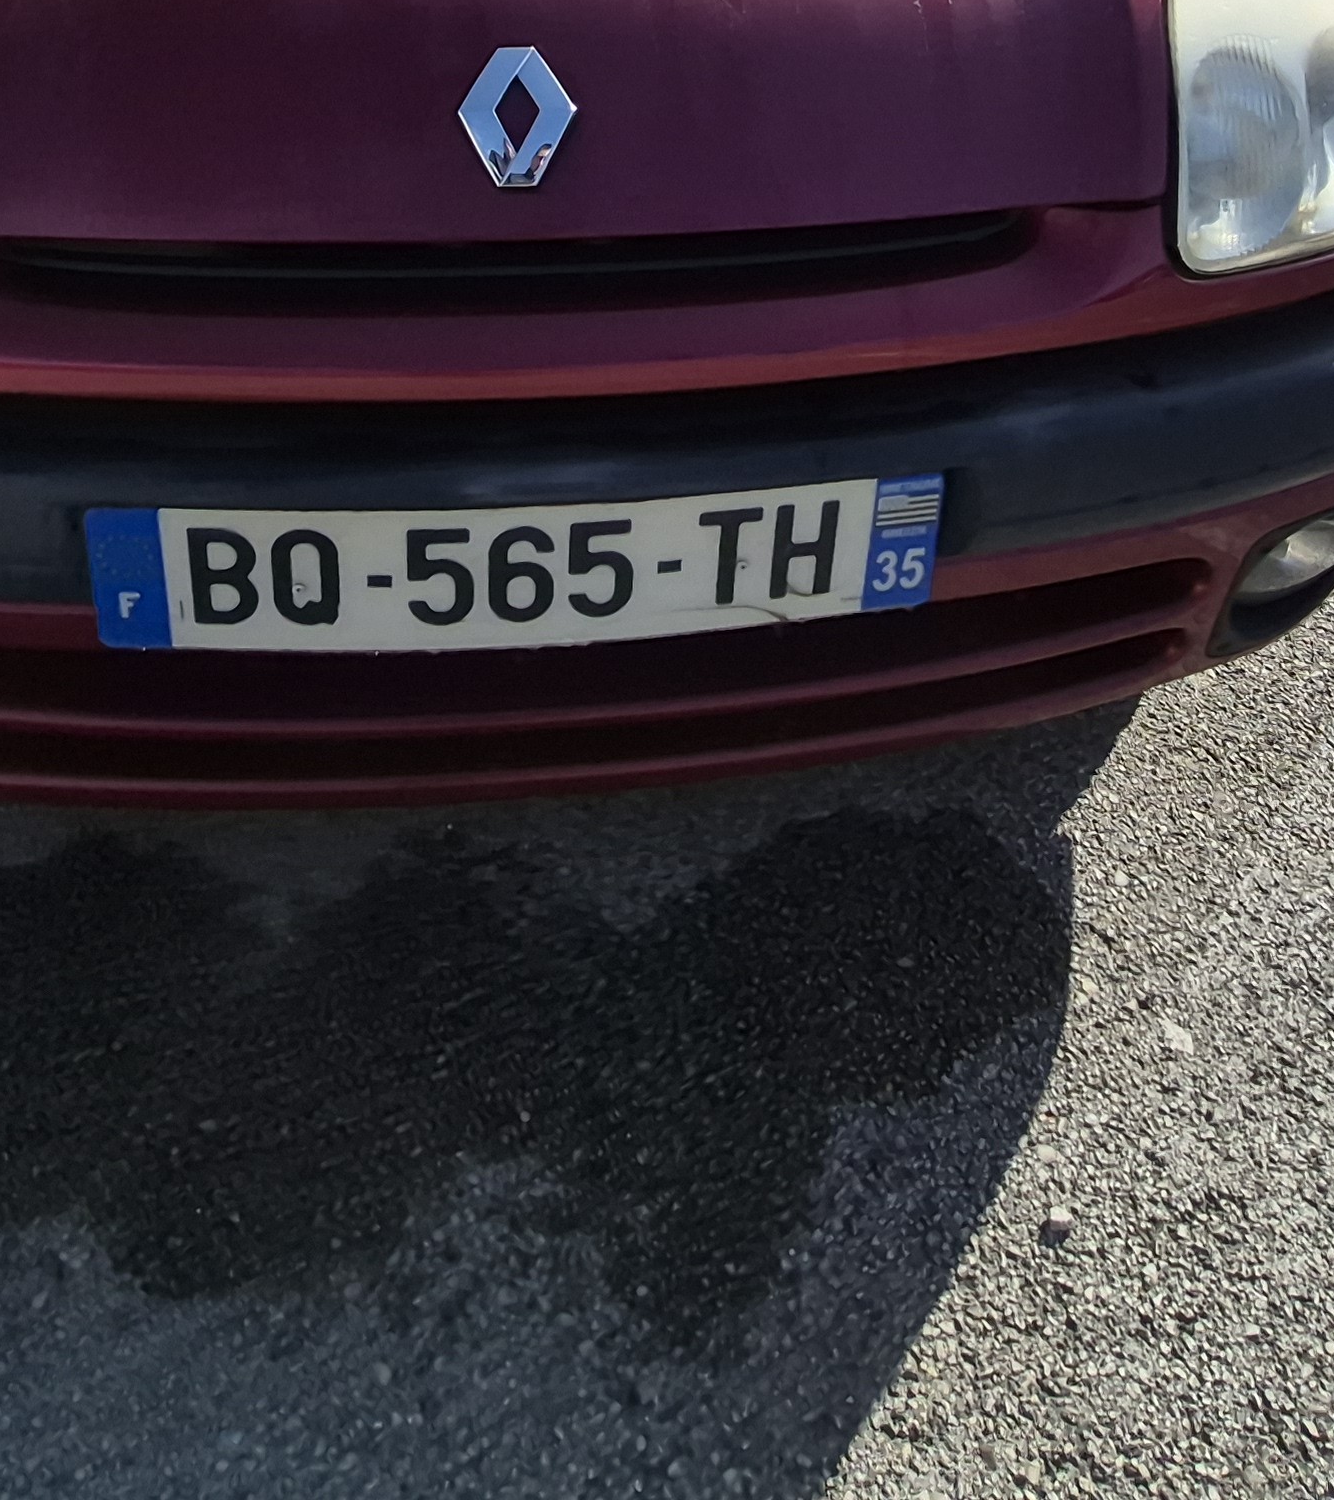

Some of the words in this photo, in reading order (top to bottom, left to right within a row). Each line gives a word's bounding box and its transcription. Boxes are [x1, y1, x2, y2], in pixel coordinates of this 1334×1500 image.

[186, 500, 840, 625] BQ-565-TH
[872, 547, 926, 592] 35
[118, 591, 141, 618] F
